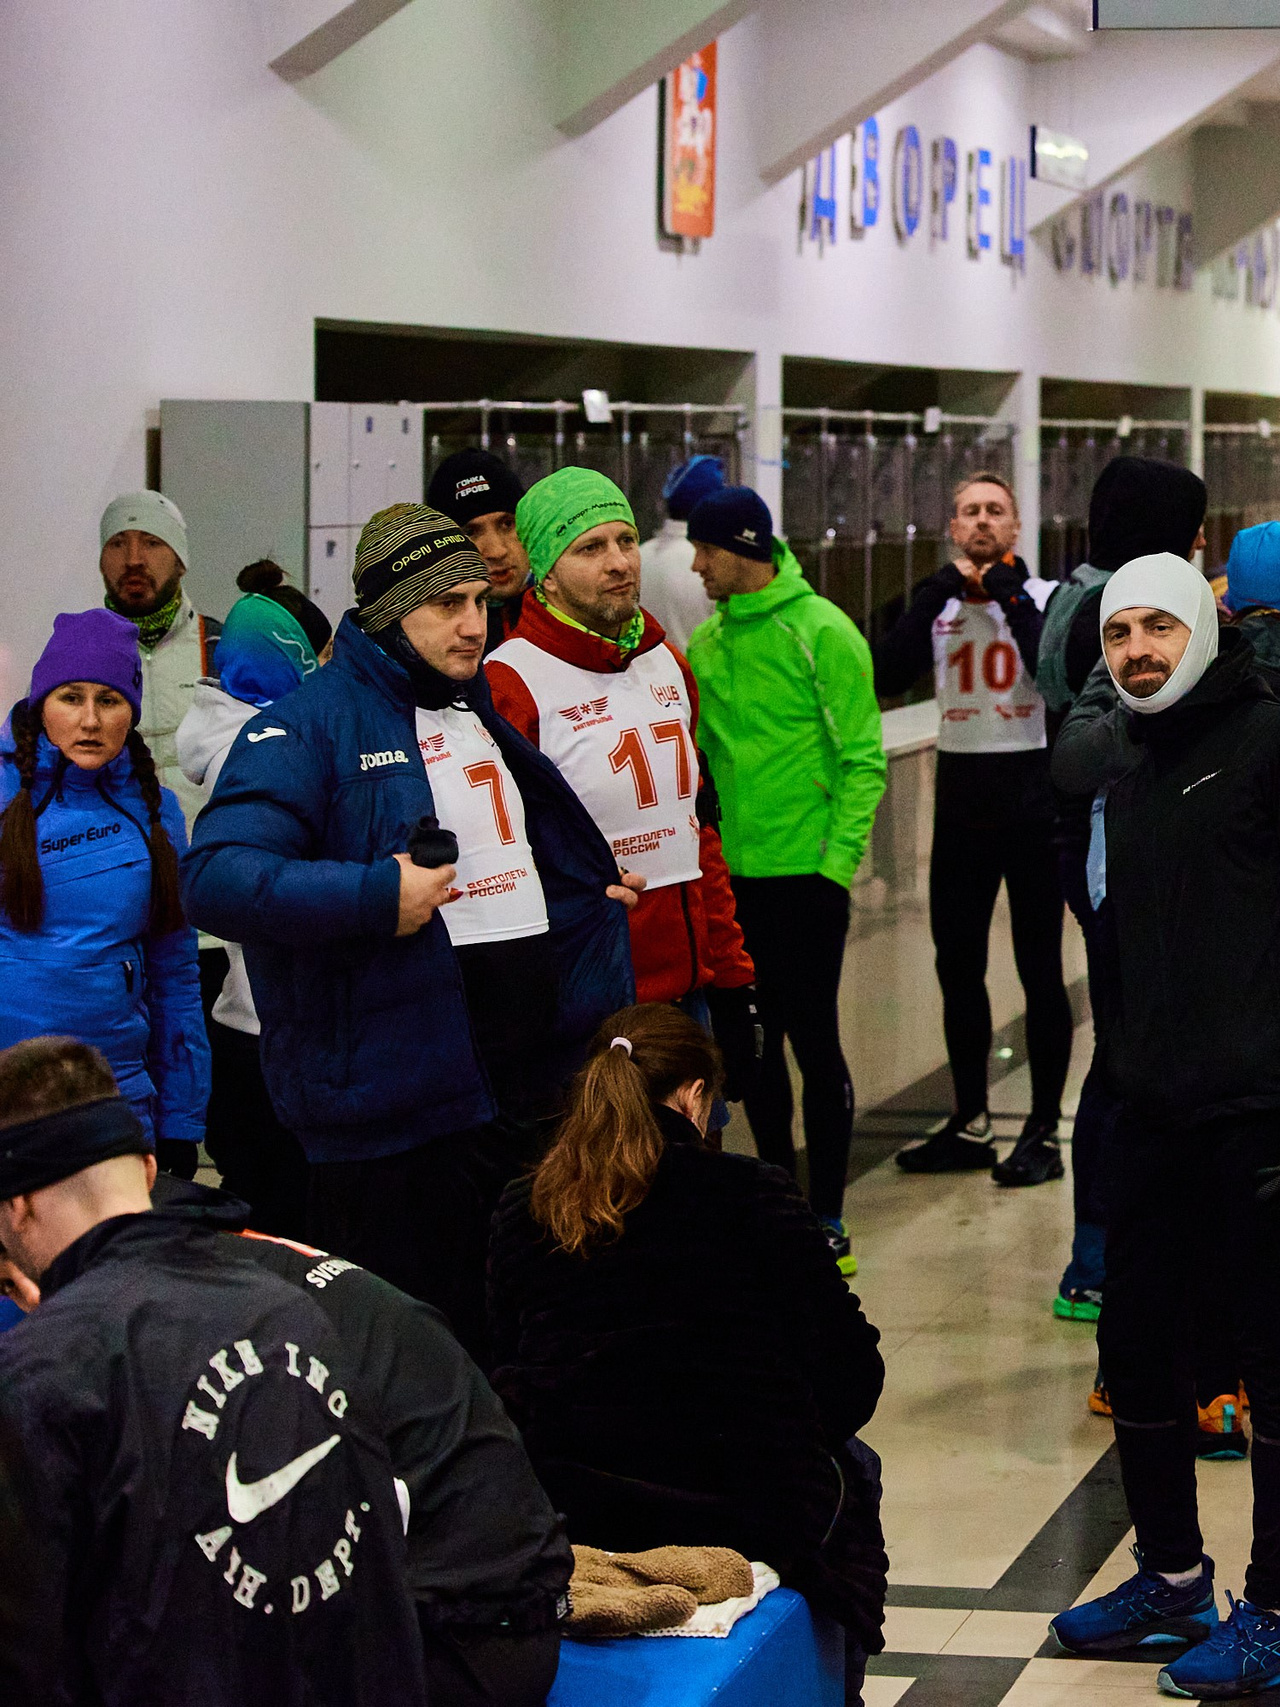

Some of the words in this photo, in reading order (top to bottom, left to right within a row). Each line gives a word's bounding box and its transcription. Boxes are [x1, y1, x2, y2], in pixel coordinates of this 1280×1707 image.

[808, 115, 1027, 277] ДВОРЕЦ
[455, 475, 486, 489] ГОНКА
[455, 483, 490, 500] ГЕРОЕВ
[947, 640, 1017, 695] 10
[607, 718, 692, 810] 17
[462, 759, 517, 846] 7
[41, 832, 85, 855] Super
[86, 822, 122, 842] Euro
[613, 827, 677, 849] ВЕРТОЛЕТЫ
[614, 841, 661, 858] РОССИИ
[466, 867, 528, 890] ВЕРТОЛЕТЫ
[468, 881, 517, 899] РОССИИ
[181, 1338, 263, 1440] NIKE
